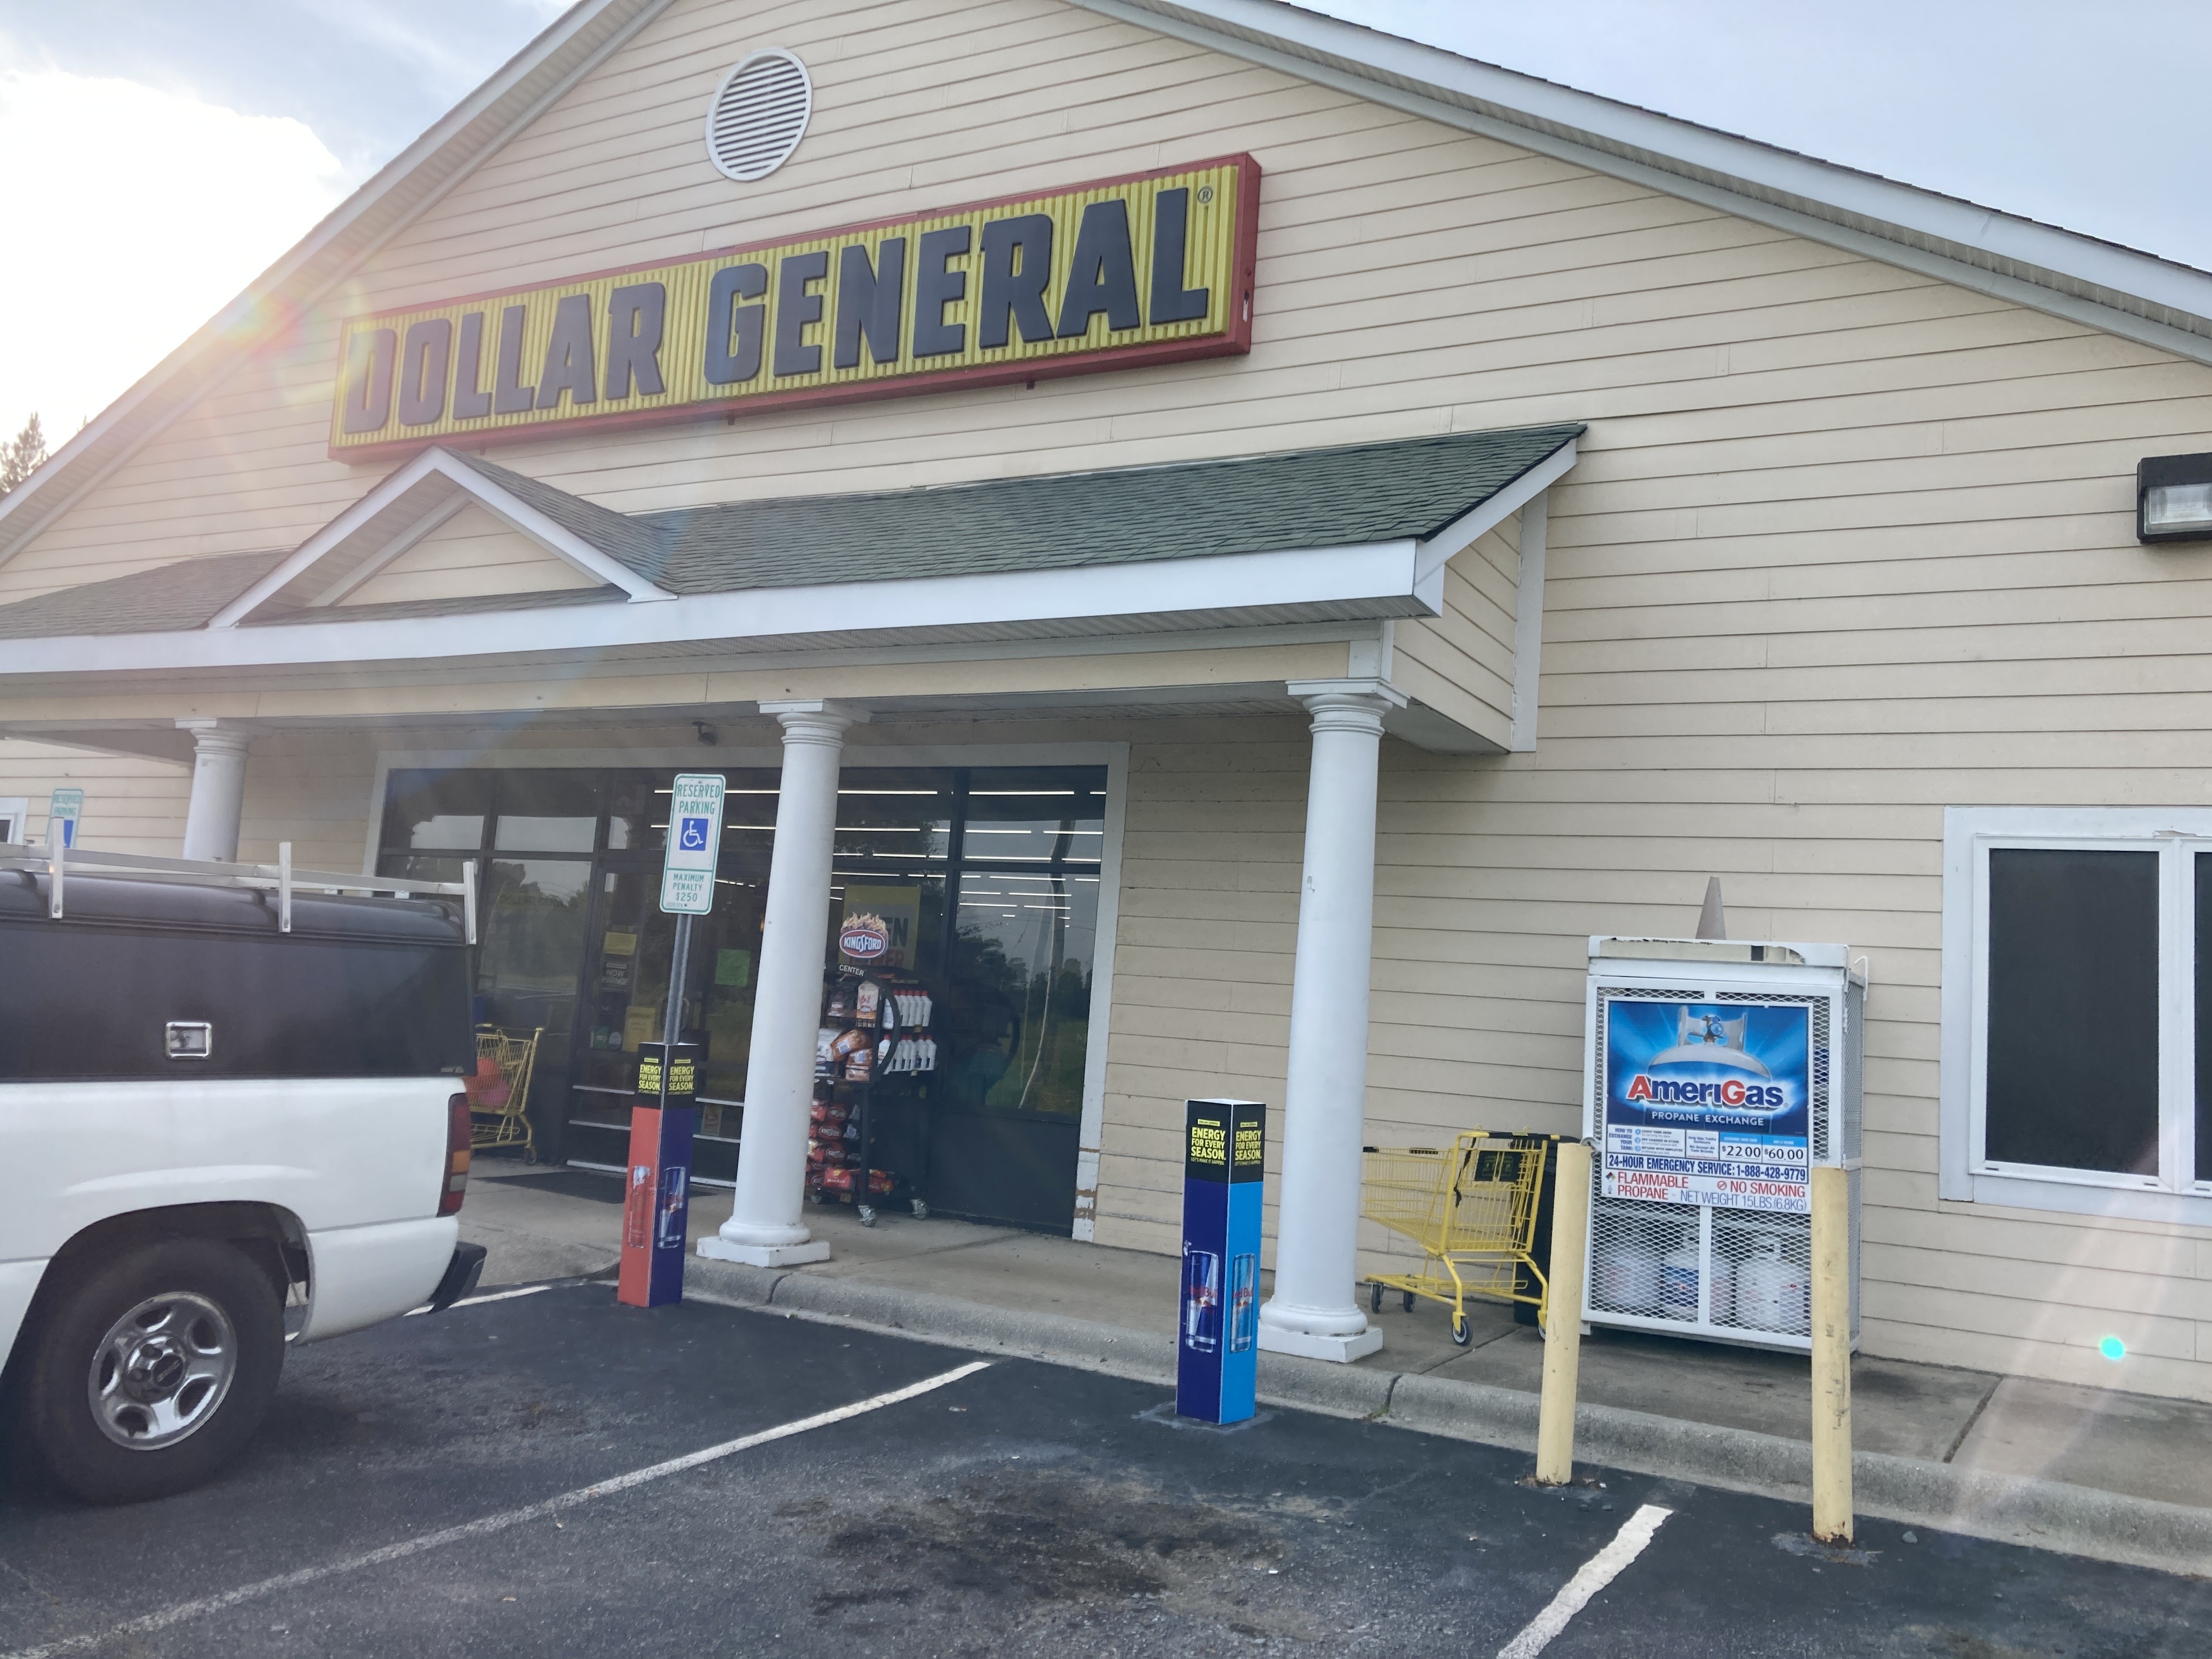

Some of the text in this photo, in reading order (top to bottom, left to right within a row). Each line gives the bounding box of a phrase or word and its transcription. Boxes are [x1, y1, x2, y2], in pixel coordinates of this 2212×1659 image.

[343, 187, 1209, 434] DOLLAR GENERAL
[677, 784, 720, 798] RESERVED
[679, 801, 715, 814] PARKING
[673, 873, 704, 882] MAXIMUM
[673, 882, 703, 891] PENALTY
[676, 892, 697, 902] $250
[844, 934, 882, 952] KINGSFORD
[607, 969, 625, 977] NOW
[839, 964, 865, 977] CENTER
[640, 1064, 662, 1075] ENERGY
[670, 1066, 695, 1075] ENERGY
[639, 1080, 661, 1091] SEASON.
[669, 1081, 694, 1091] SEASON.
[1628, 1075, 1783, 1107] AmeriGas
[1652, 1111, 1764, 1126] PROPANE EXCHANGE
[1192, 1127, 1226, 1141] ENERGY
[1235, 1130, 1262, 1142] ENERGY
[1192, 1138, 1225, 1149] FOR EVERY
[1235, 1141, 1261, 1150] FOR EVERY
[1190, 1146, 1227, 1161] SEASON.
[1235, 1149, 1262, 1161] SEASON.
[1764, 1148, 1803, 1161] $60.00
[1609, 1154, 1805, 1181] 24-HOUR EMERGENCY SERVICE: 1-888-428-9779
[1618, 1171, 1689, 1189] FLAMMABLE
[1618, 1184, 1668, 1200] PROPANE
[1730, 1181, 1805, 1198] NO SMOKING
[1680, 1189, 1700, 1203] NET
[1701, 1191, 1740, 1206] WEIGHT
